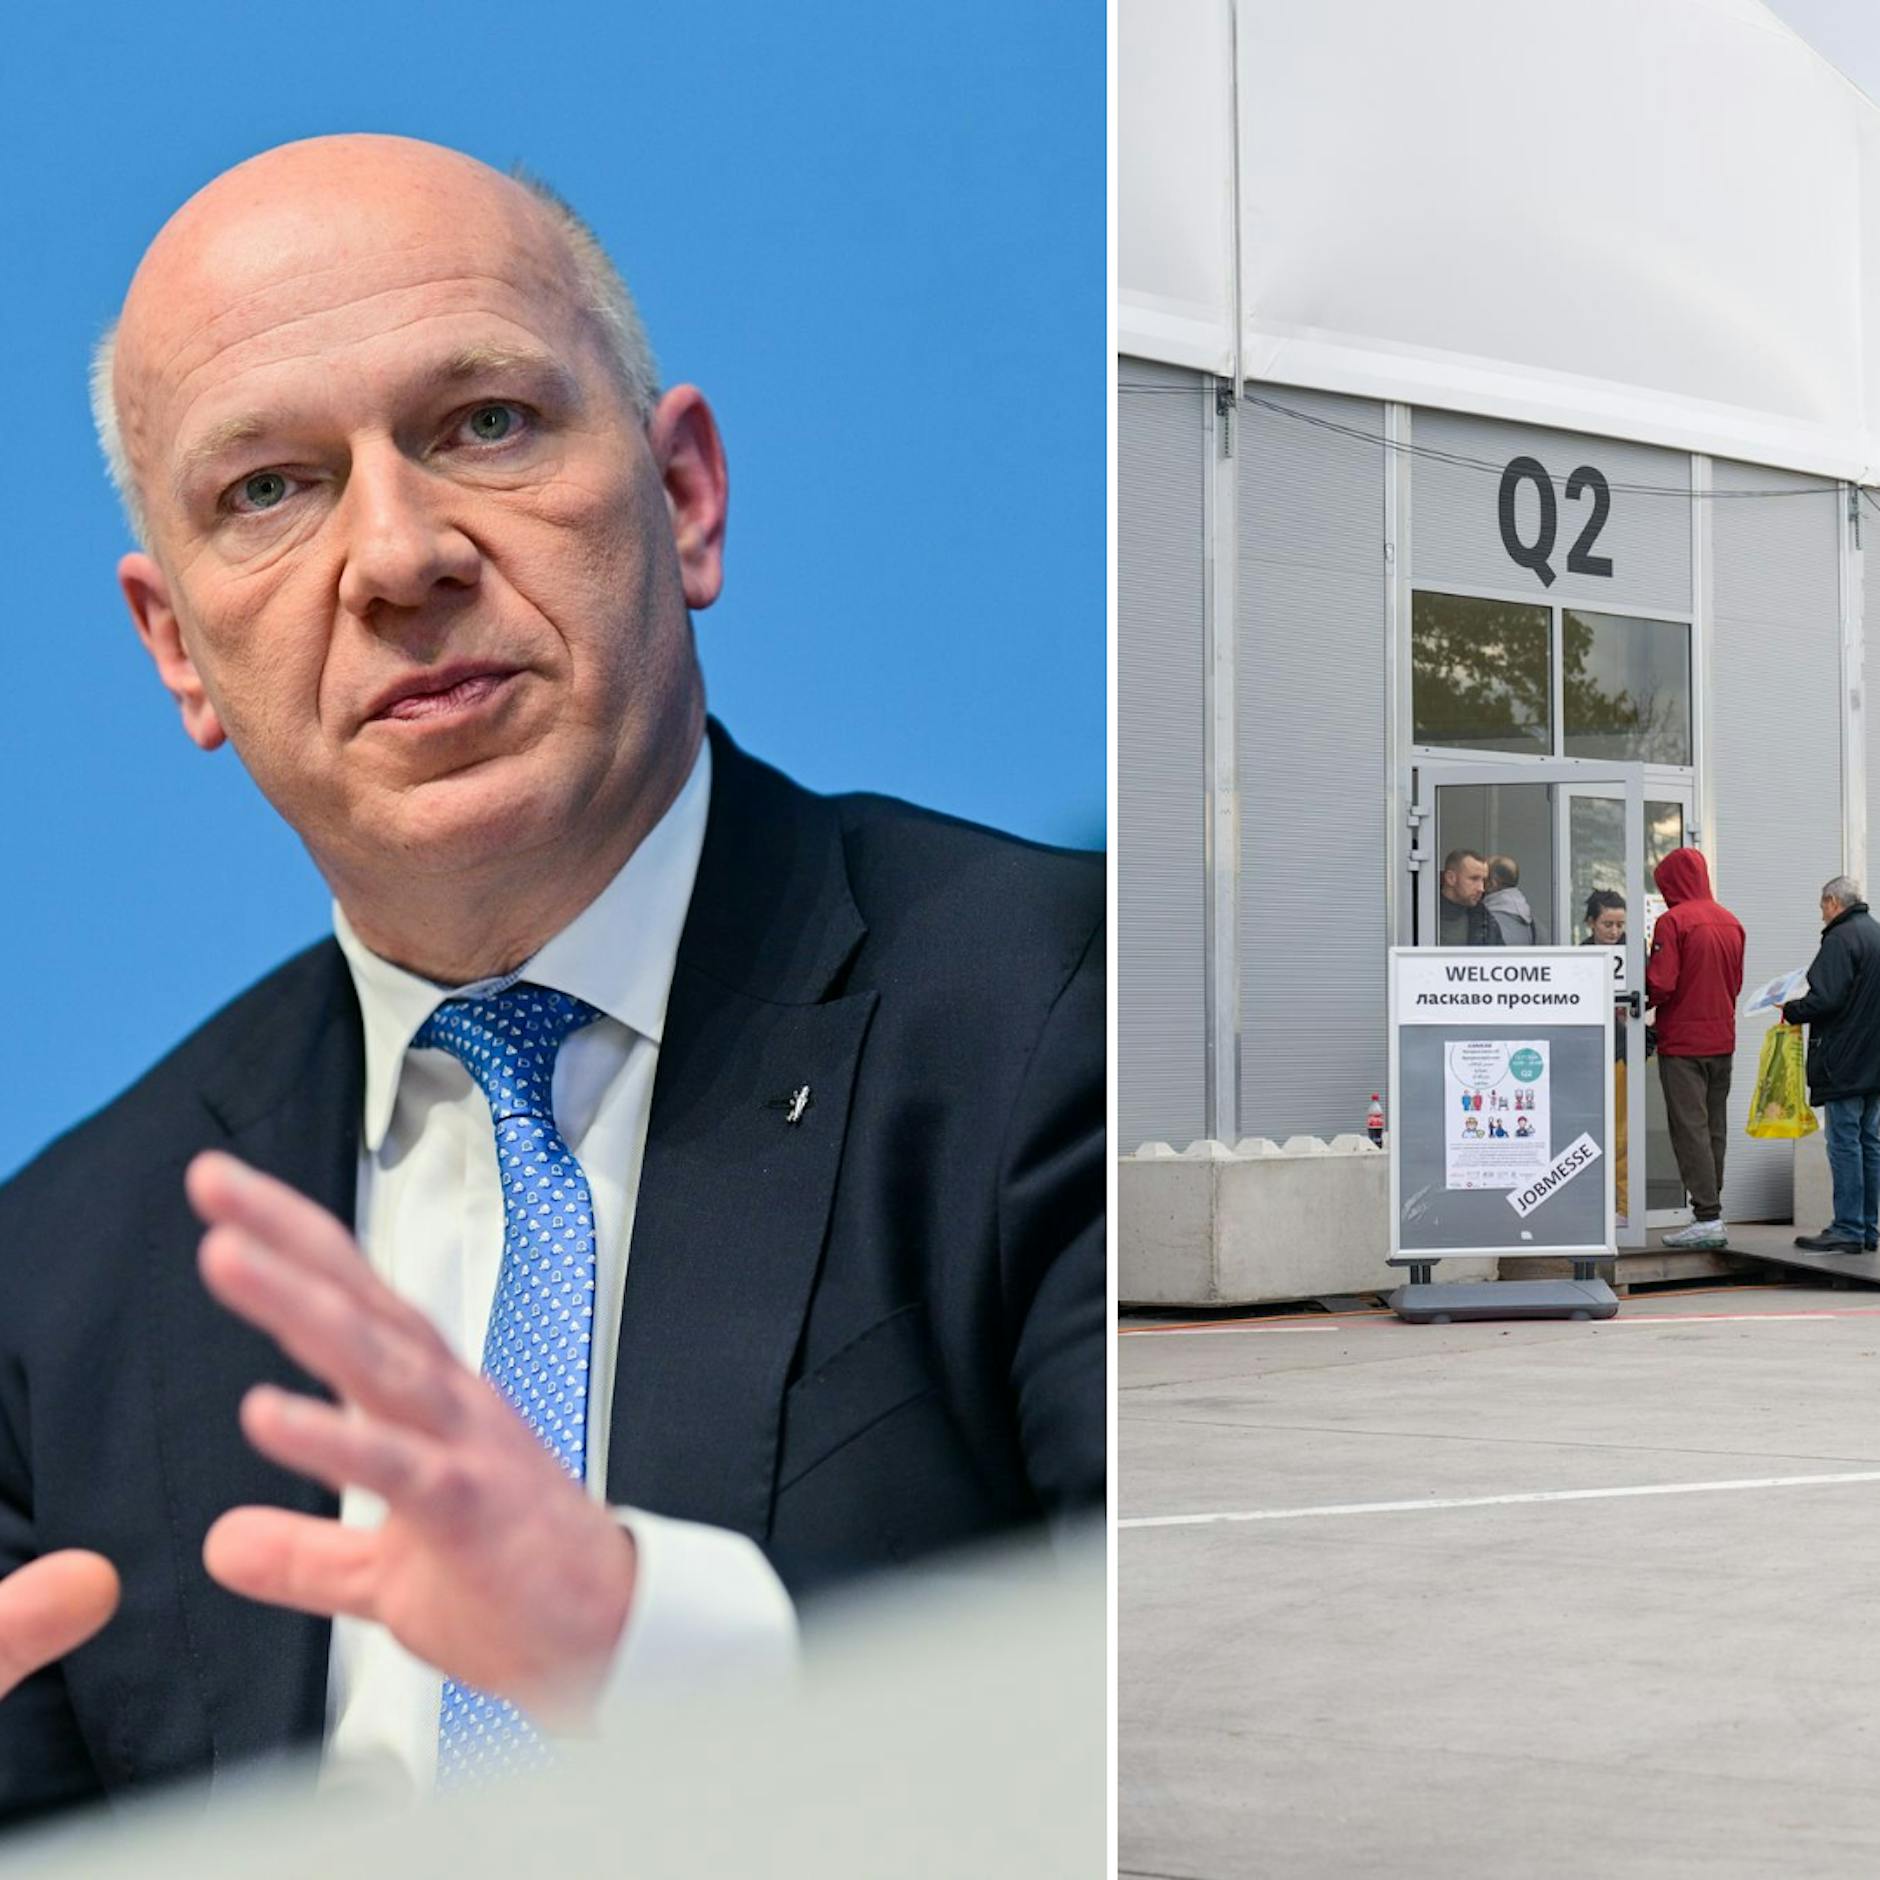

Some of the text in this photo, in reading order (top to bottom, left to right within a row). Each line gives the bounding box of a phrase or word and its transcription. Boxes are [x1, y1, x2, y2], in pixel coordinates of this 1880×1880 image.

[1498, 455, 1613, 589] Q2
[1445, 965, 1552, 983] WELCOME
[1415, 992, 1581, 1009] ласкаво просимо
[1517, 1143, 1594, 1212] JOBMESSE
